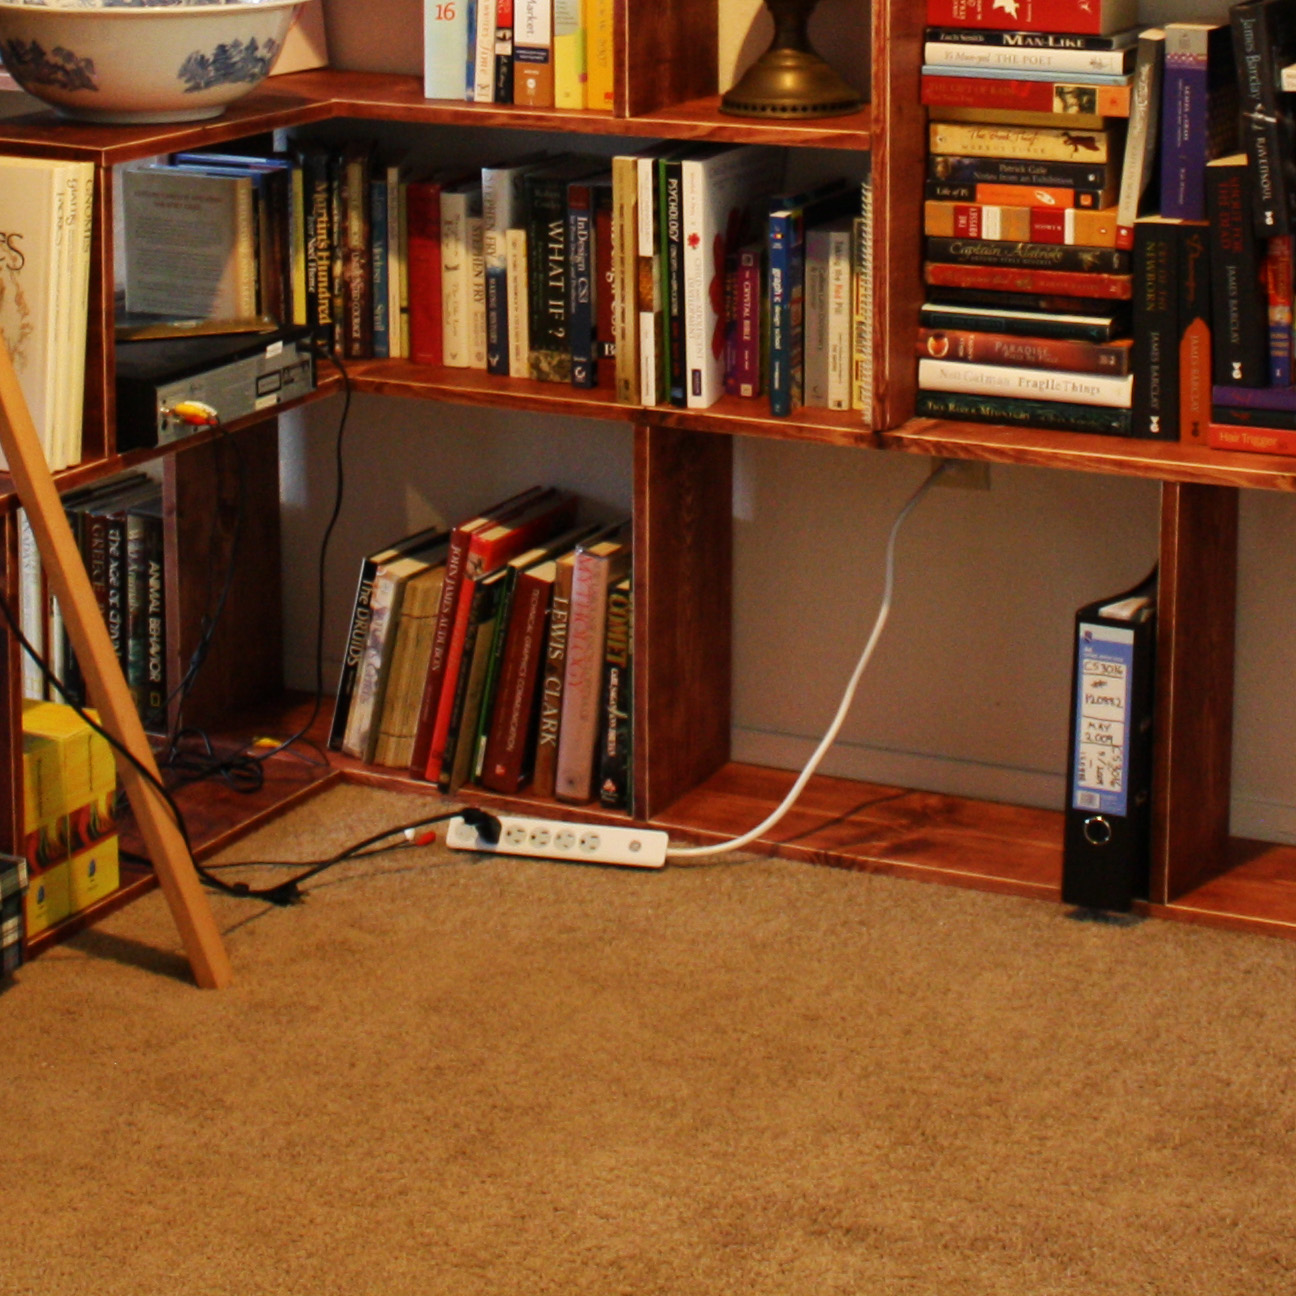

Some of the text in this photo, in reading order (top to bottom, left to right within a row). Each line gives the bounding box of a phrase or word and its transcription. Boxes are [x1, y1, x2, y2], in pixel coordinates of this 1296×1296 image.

[434, 1, 456, 21] 16
[1239, 17, 1256, 55] James
[996, 54, 1052, 65] THE POET
[1002, 34, 1085, 48] MAN-LIKE
[1245, 55, 1261, 101] Barclay
[667, 177, 679, 242] PSYCHOLOGY
[312, 180, 333, 325] Martin's Hundred
[472, 225, 484, 304] STEPHEN FRY
[547, 220, 564, 292] WHAT
[571, 215, 589, 271] InDesign
[771, 267, 783, 303] graphic
[834, 283, 842, 299] Red
[1226, 266, 1238, 296] JAMES
[548, 299, 564, 320] IF
[743, 281, 751, 341] CRYSTAL BIBLE
[1017, 376, 1060, 391] Fragile
[1062, 380, 1101, 395] Things
[1150, 331, 1161, 410] JAMES BARCLAY
[149, 560, 161, 681] ANIMAL BEHAVIOR
[347, 578, 373, 666] The DRUIDS
[431, 544, 463, 671] JOHN JAMES AUDUBON
[540, 596, 569, 748] LEWIS CLARK
